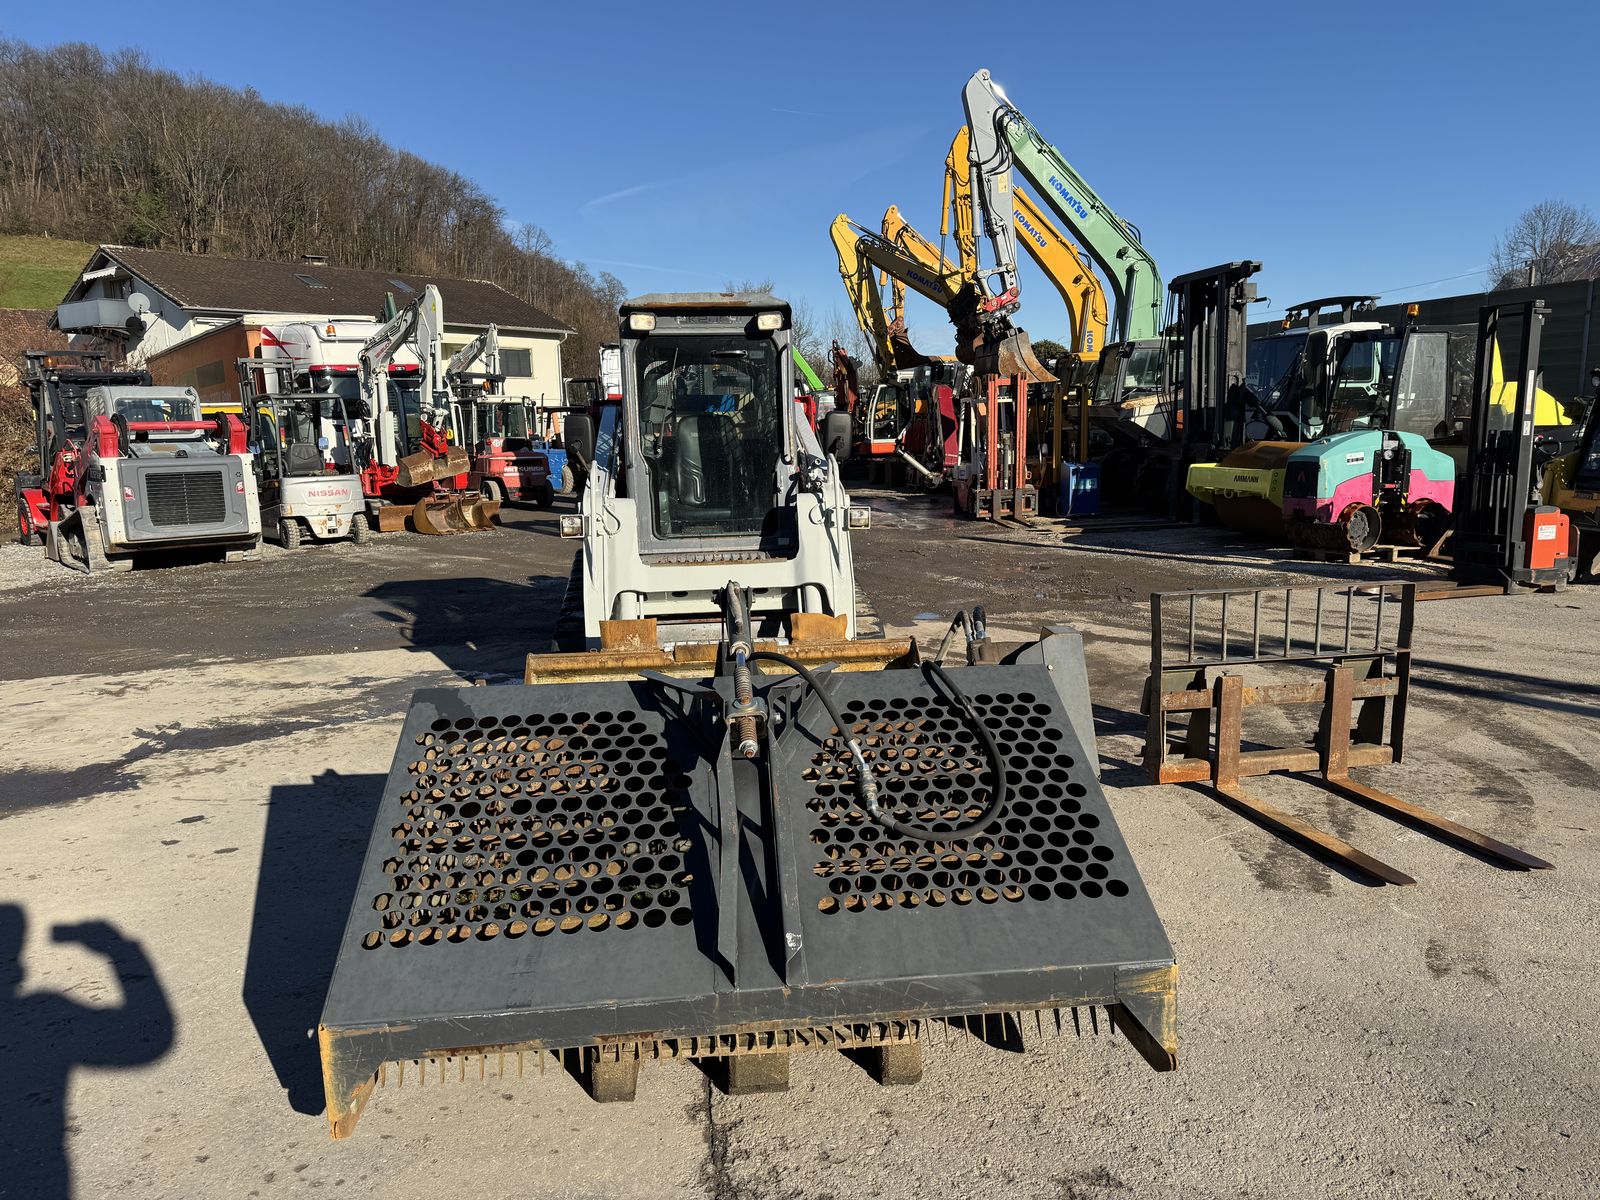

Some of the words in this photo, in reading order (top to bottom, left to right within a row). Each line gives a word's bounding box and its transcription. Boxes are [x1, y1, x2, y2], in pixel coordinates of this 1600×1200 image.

[1048, 175, 1088, 219] KOMATSU
[1013, 209, 1047, 247] KOMATSU
[308, 489, 348, 497] NISSAN
